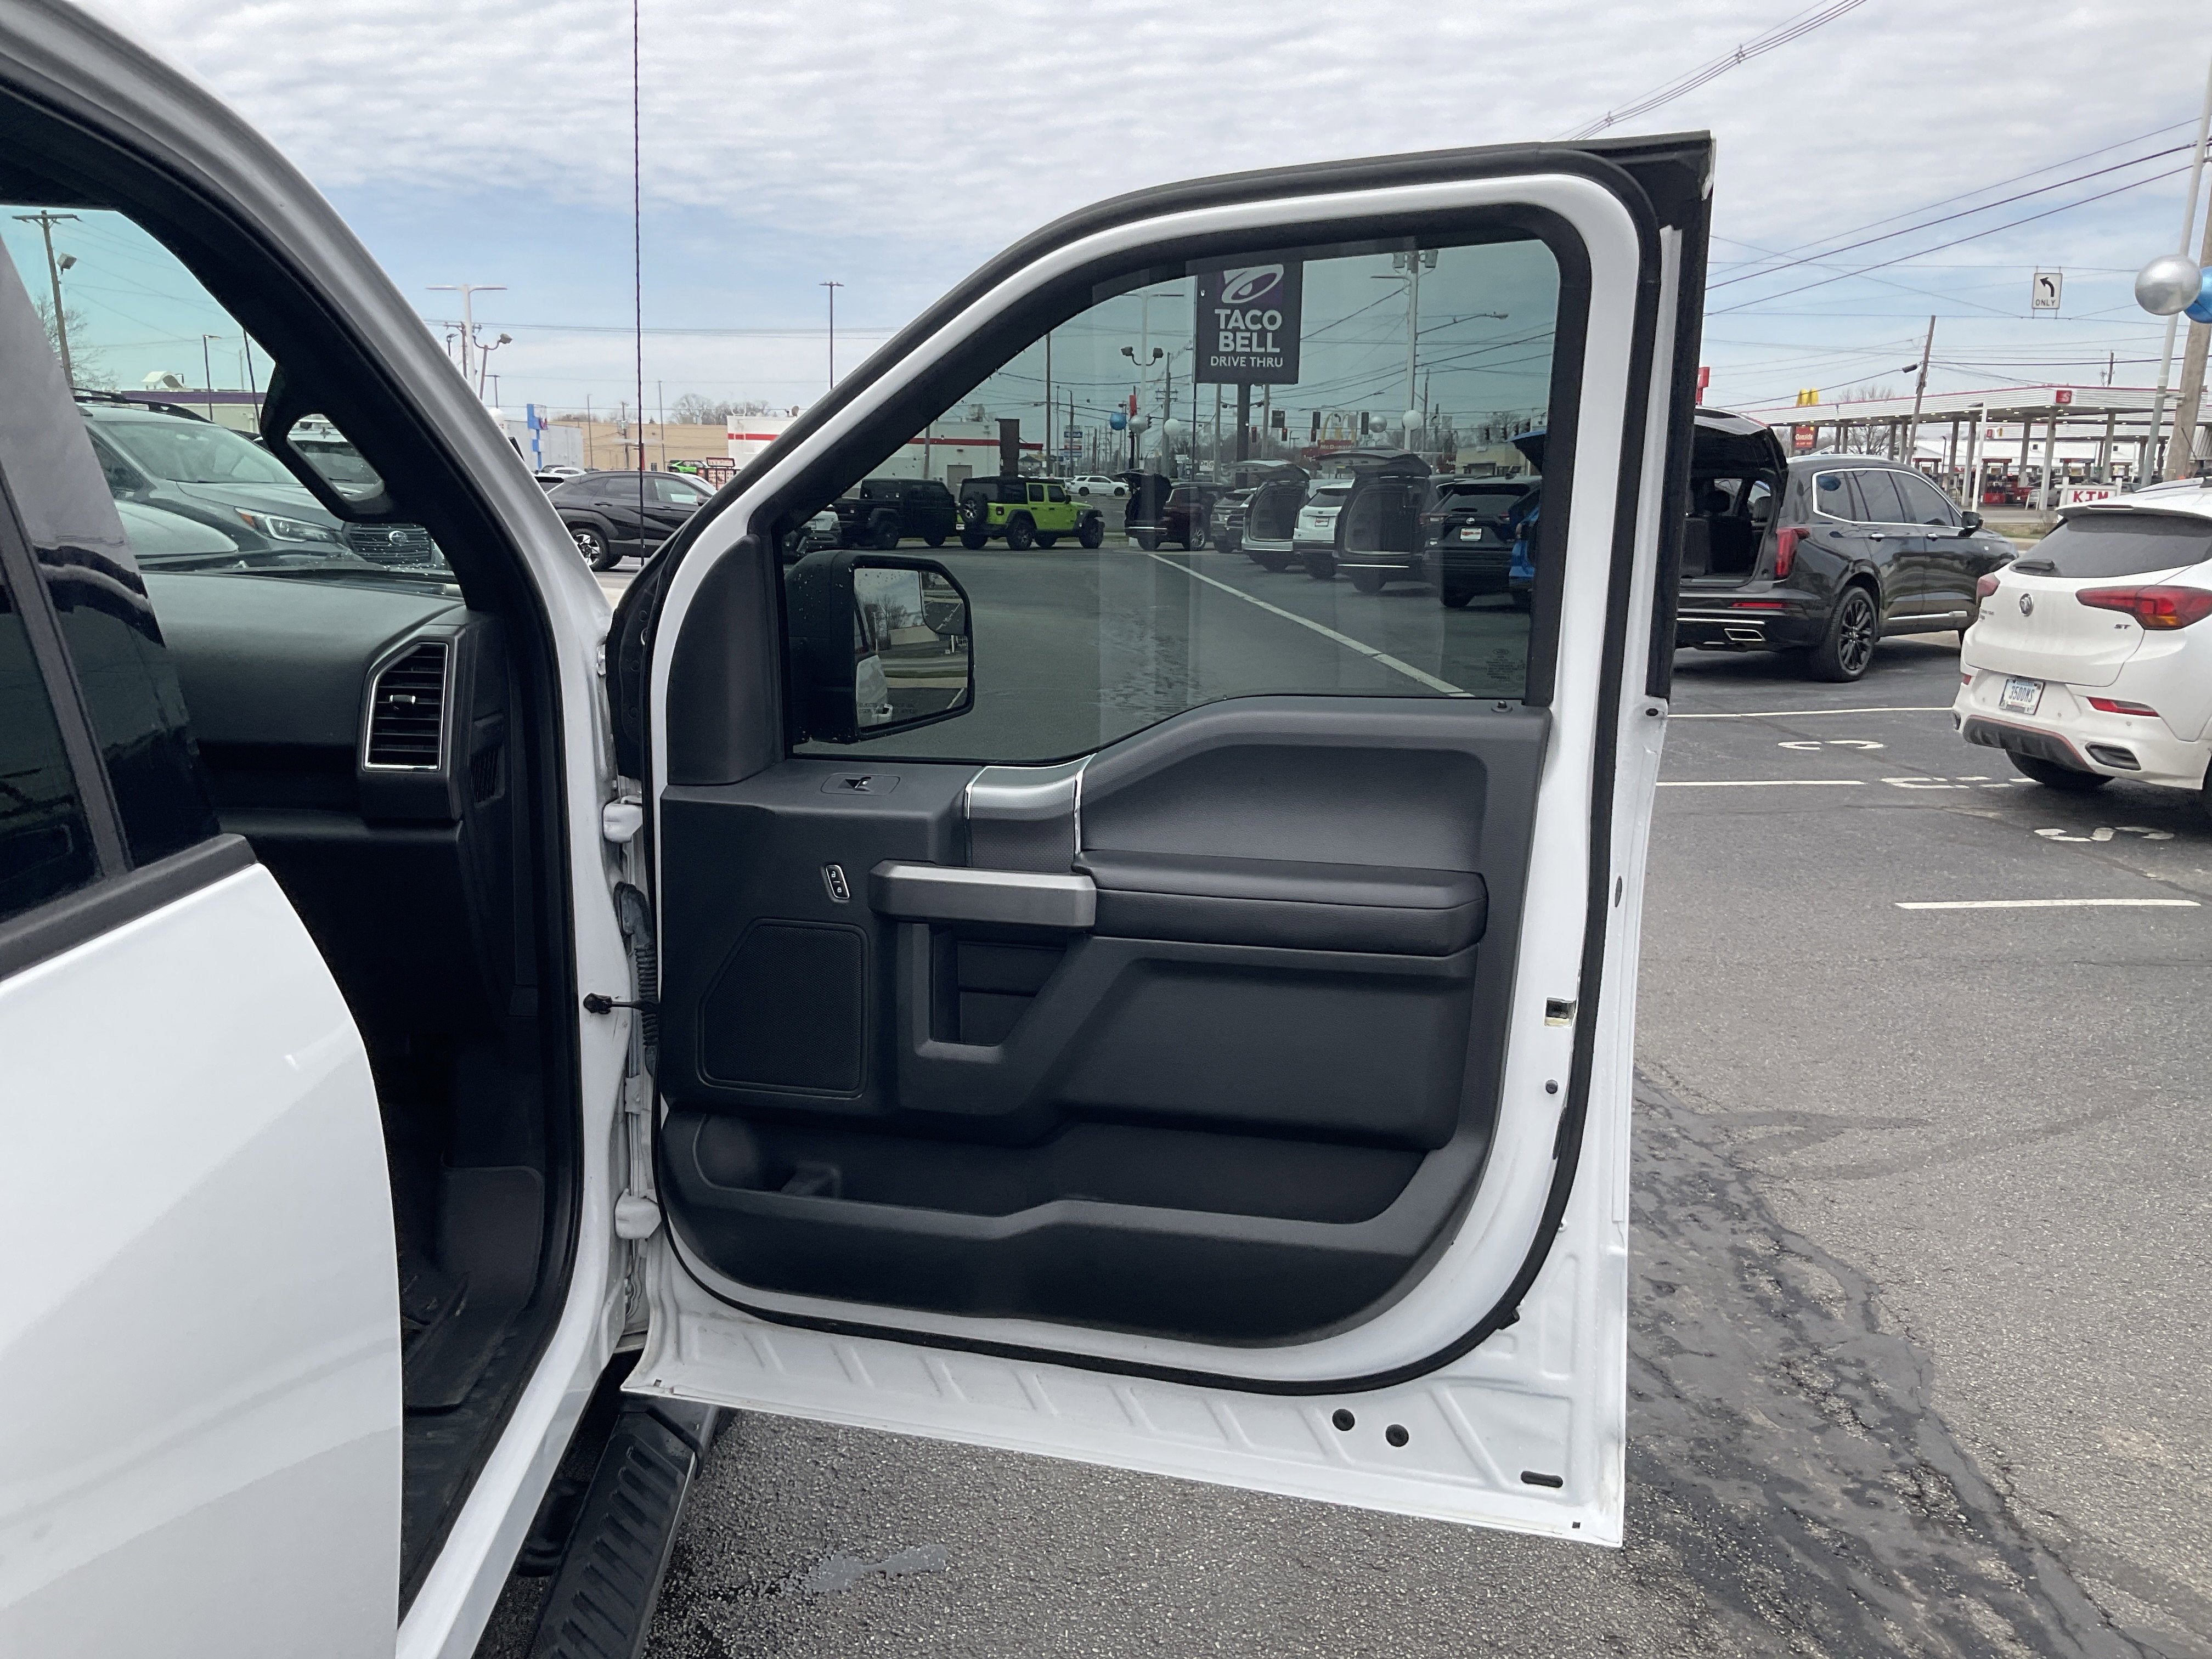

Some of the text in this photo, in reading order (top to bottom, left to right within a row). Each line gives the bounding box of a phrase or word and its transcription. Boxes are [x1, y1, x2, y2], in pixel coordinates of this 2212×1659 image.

[1214, 309, 1282, 330] TACO
[1218, 331, 1280, 353] BELL
[1210, 356, 1284, 367] DRIVE THRU
